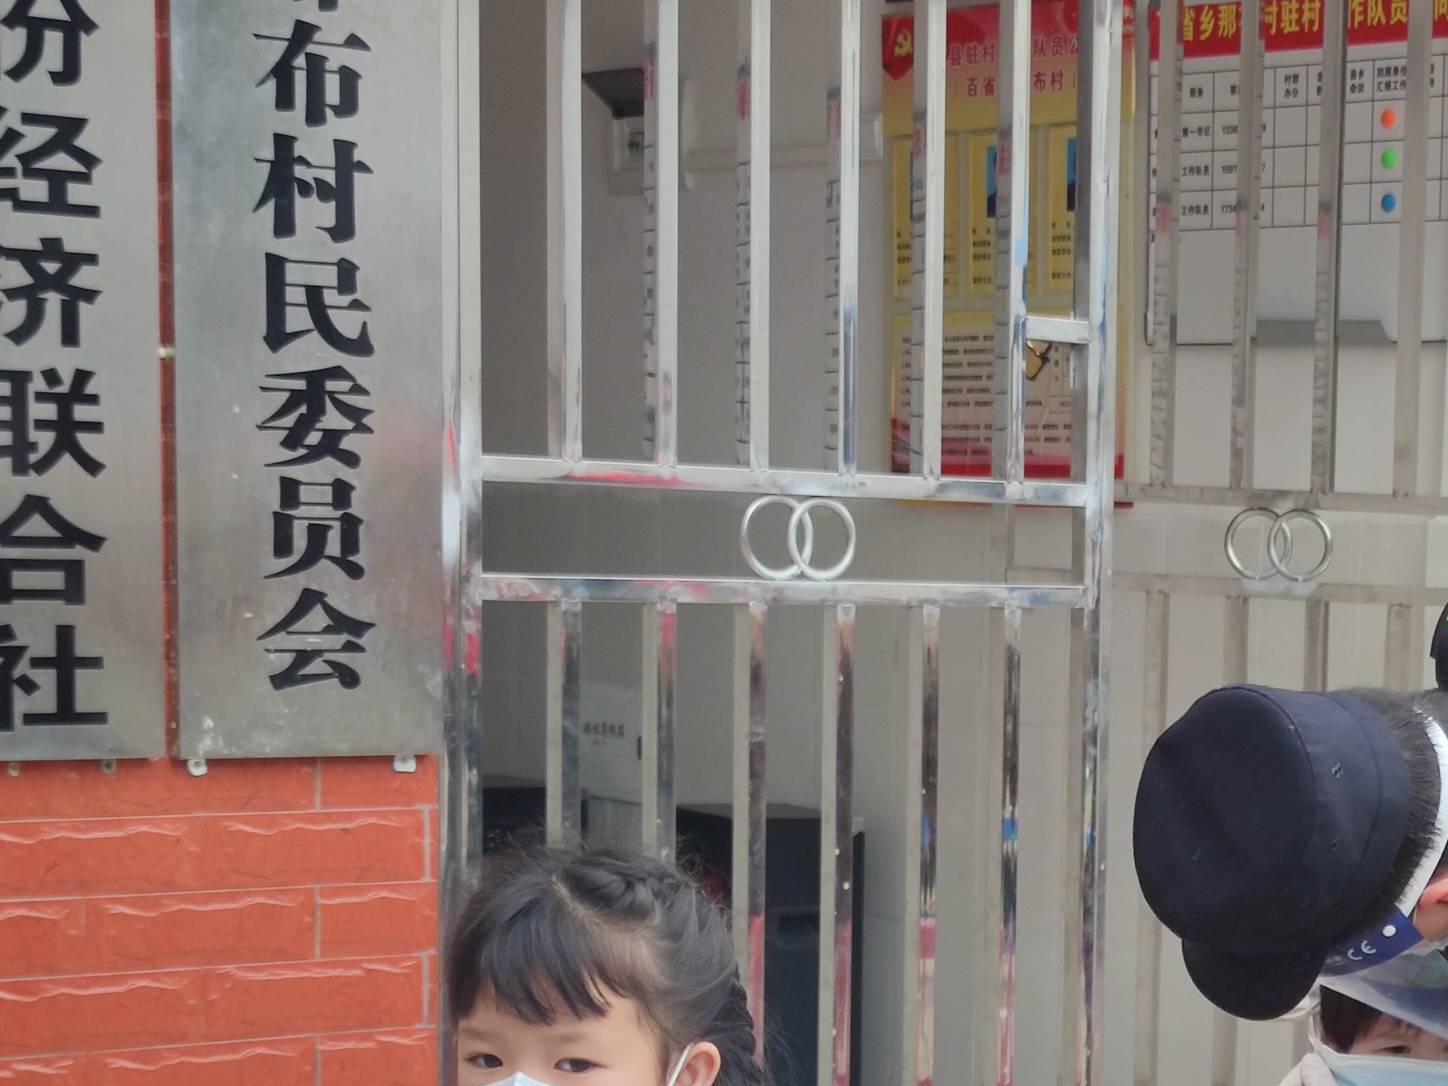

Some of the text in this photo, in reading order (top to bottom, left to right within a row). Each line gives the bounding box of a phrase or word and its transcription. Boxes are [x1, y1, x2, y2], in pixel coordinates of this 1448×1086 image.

[251, 0, 376, 691] 布村民委员会
